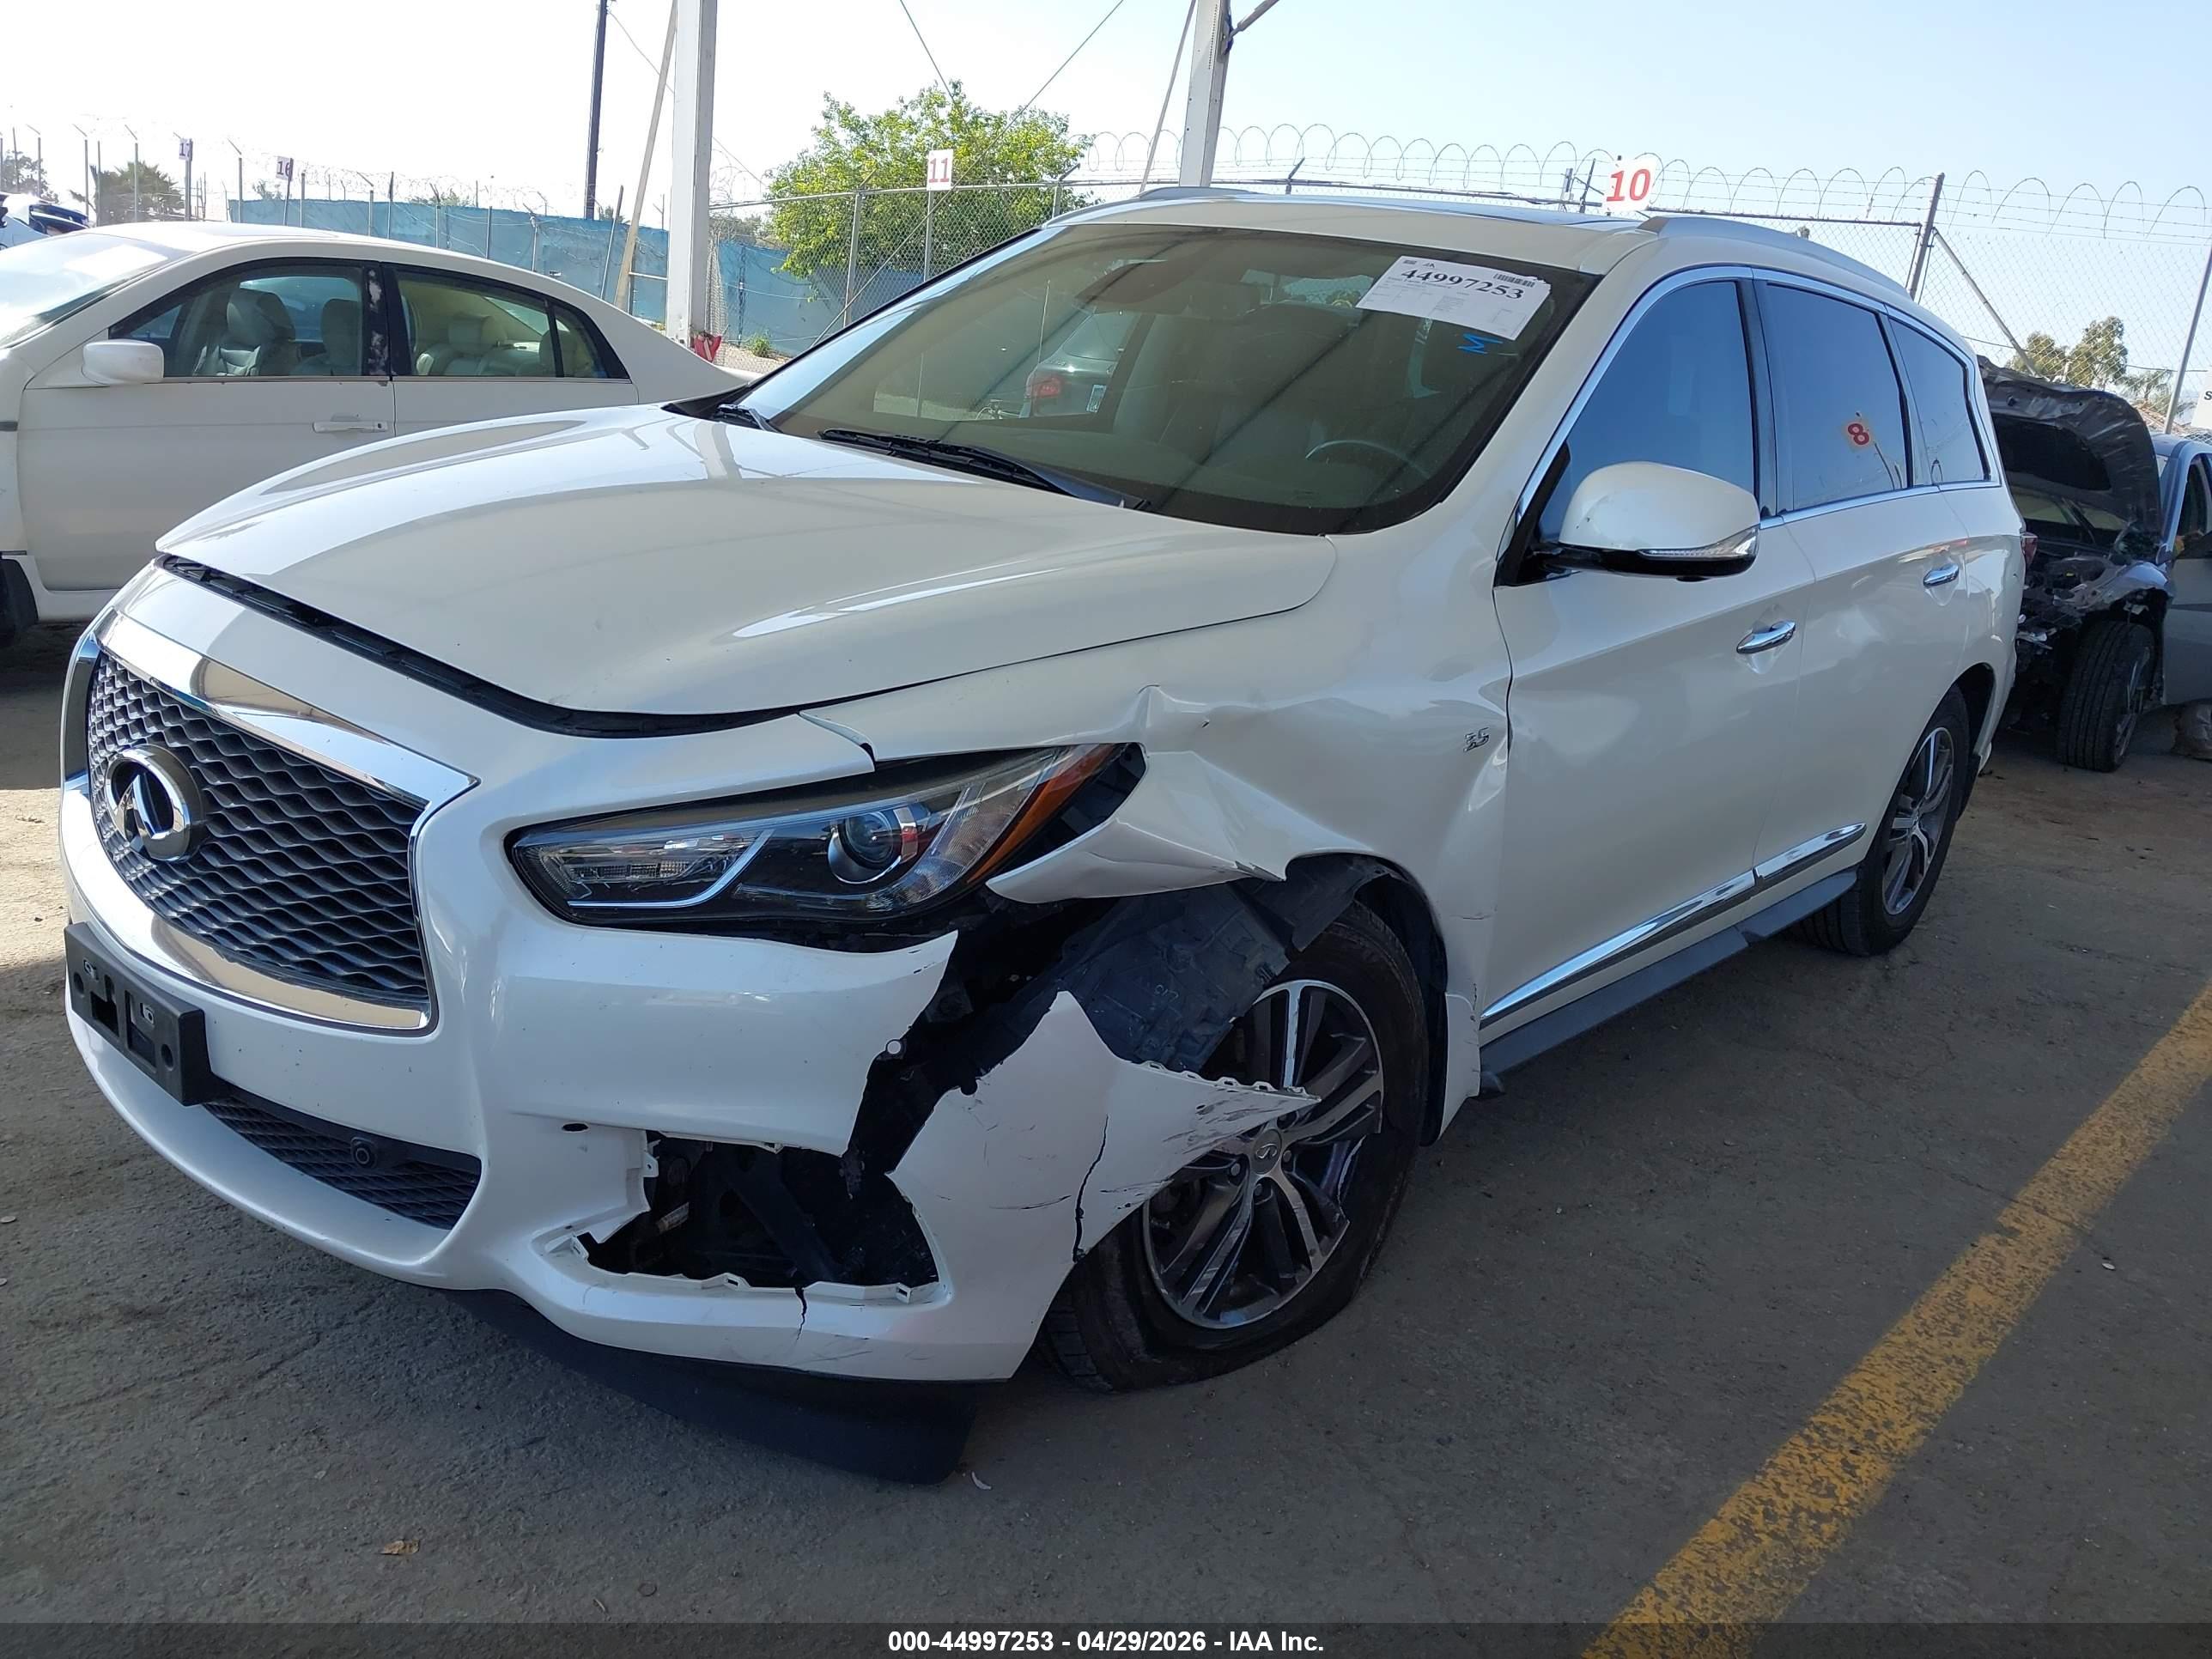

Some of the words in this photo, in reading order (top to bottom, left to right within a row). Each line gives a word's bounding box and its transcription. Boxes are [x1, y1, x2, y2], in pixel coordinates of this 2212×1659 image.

[928, 157, 950, 183] 11
[1606, 168, 1651, 202] 10
[1401, 269, 1524, 300] 44997253
